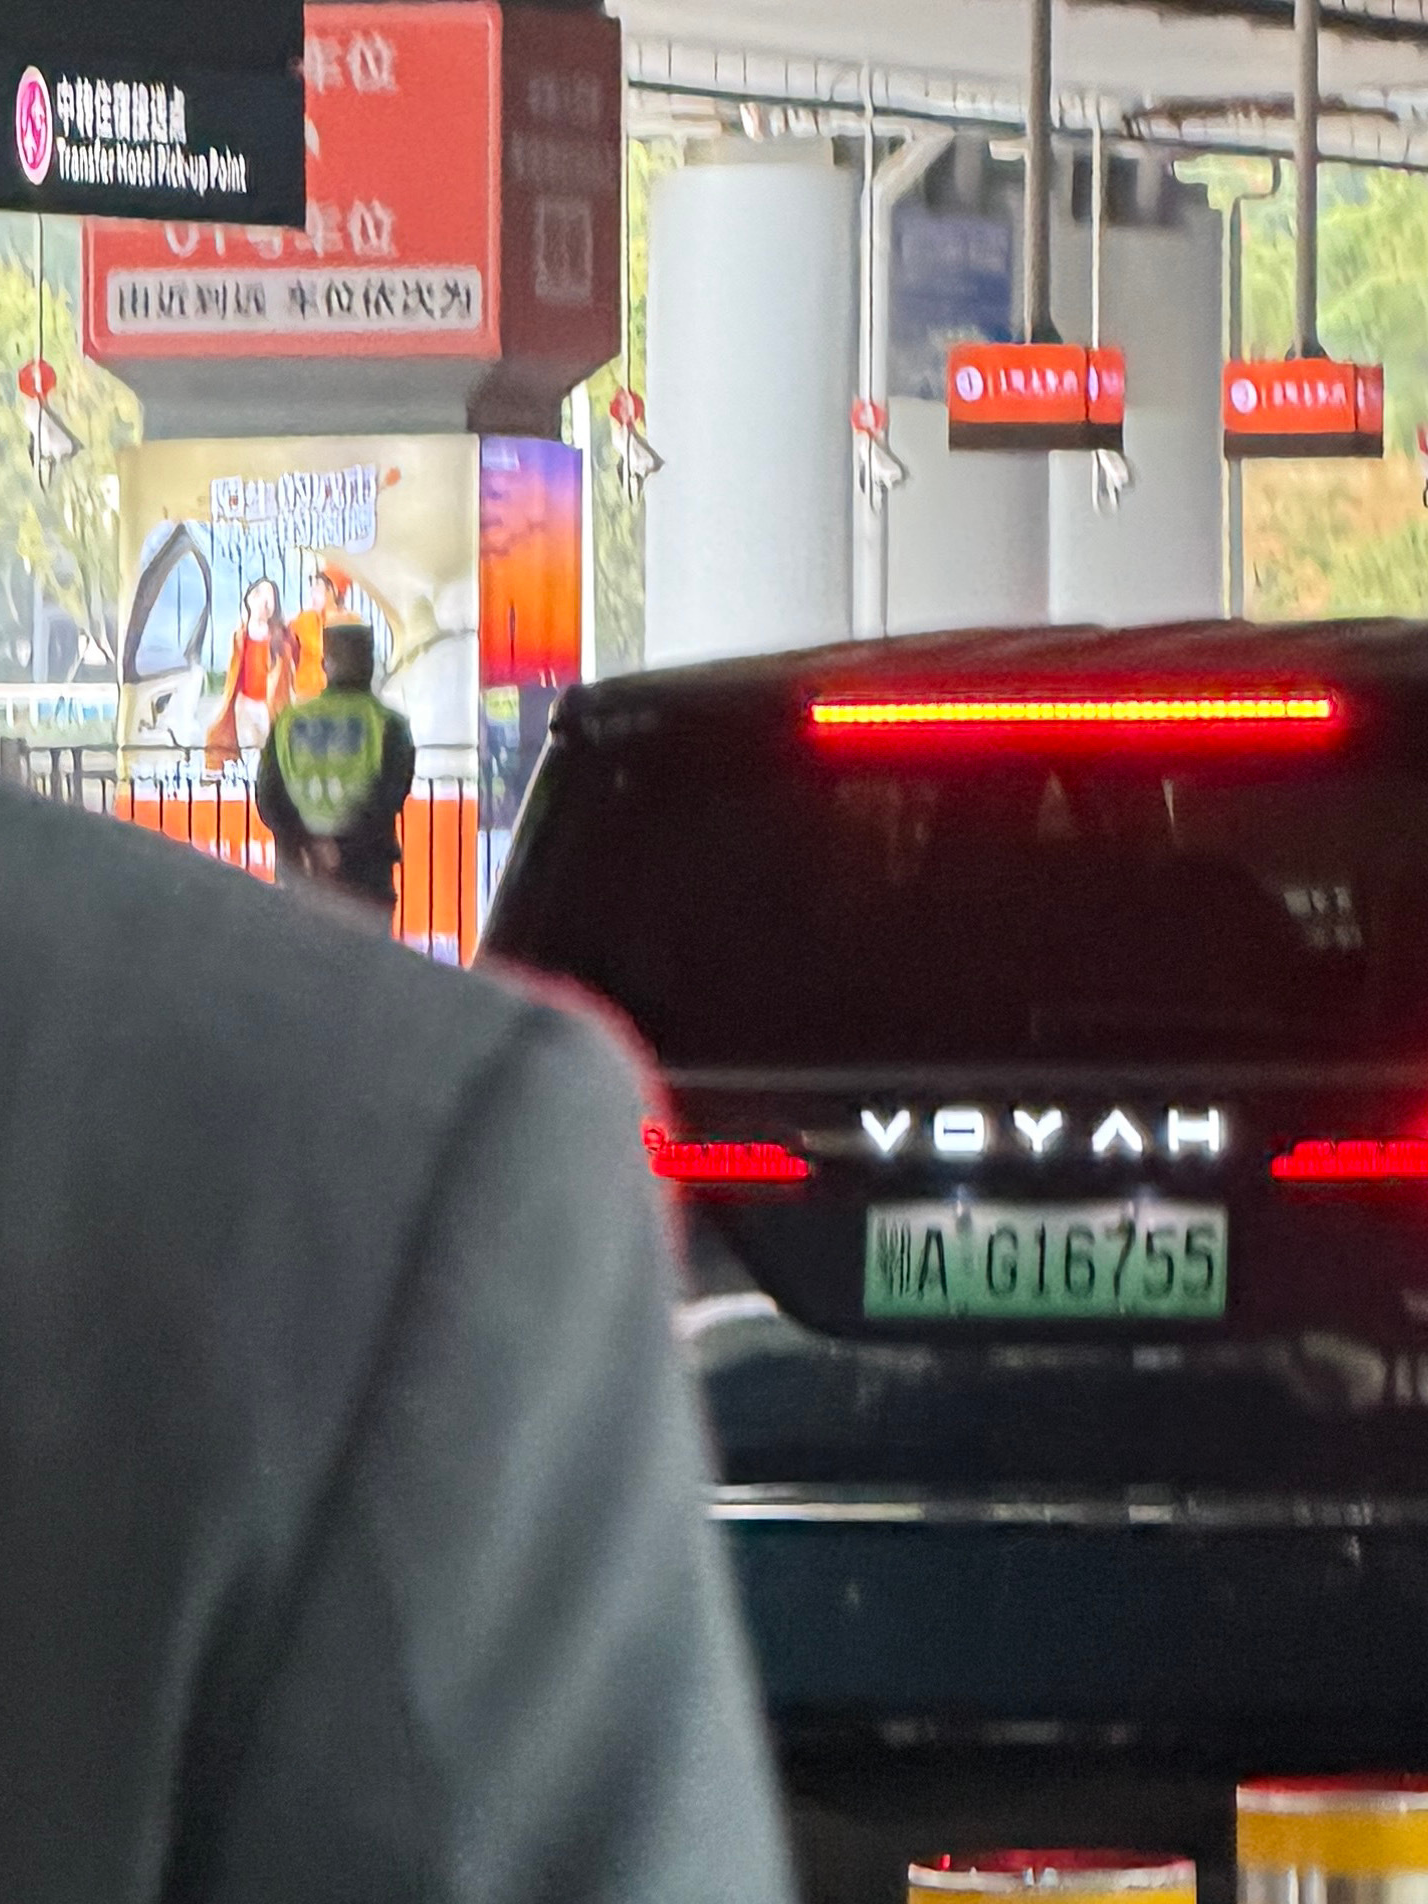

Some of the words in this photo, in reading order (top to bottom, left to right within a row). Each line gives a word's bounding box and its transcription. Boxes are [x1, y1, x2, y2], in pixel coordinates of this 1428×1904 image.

[56, 136, 115, 186] Transfer
[117, 142, 156, 189] Hotel
[158, 144, 208, 196] Pick-up
[210, 145, 247, 194] Point
[861, 1108, 1220, 1153] VOYAH
